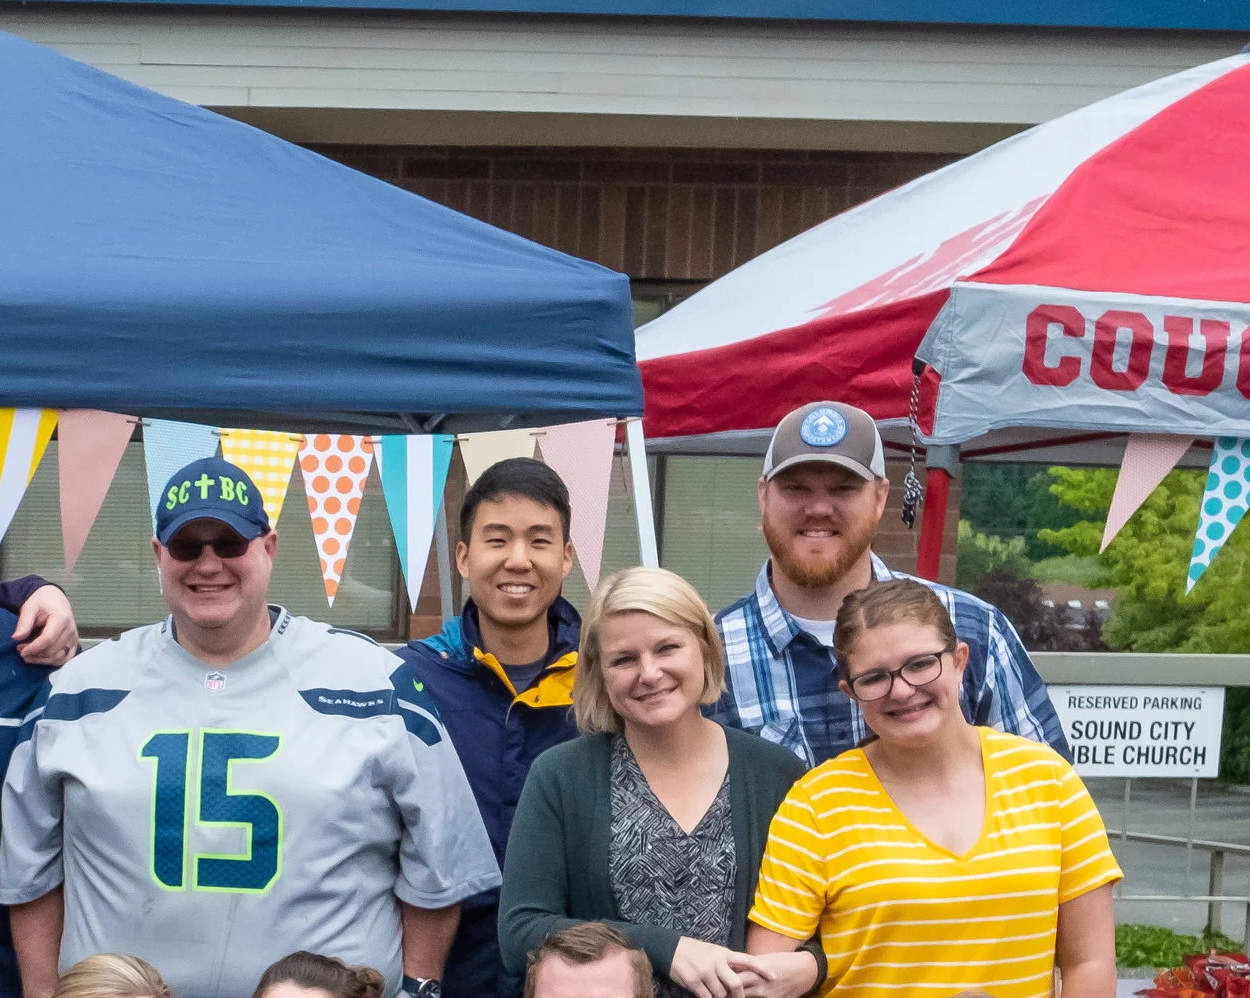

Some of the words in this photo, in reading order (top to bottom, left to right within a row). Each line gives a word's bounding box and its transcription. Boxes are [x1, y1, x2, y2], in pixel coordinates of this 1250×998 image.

[1022, 304, 1250, 399] COU
[166, 480, 191, 509] SC
[219, 475, 248, 505] BC
[207, 680, 223, 689] NFL
[318, 695, 383, 707] SEAHAWKS
[1068, 696, 1138, 709] RESERVED
[1143, 696, 1201, 710] PARKING
[1070, 720, 1141, 740] SOUND
[1150, 721, 1196, 741] CITY
[1072, 745, 1115, 764] IBLE
[1122, 745, 1206, 765] CHURCH
[136, 727, 284, 894] 15
